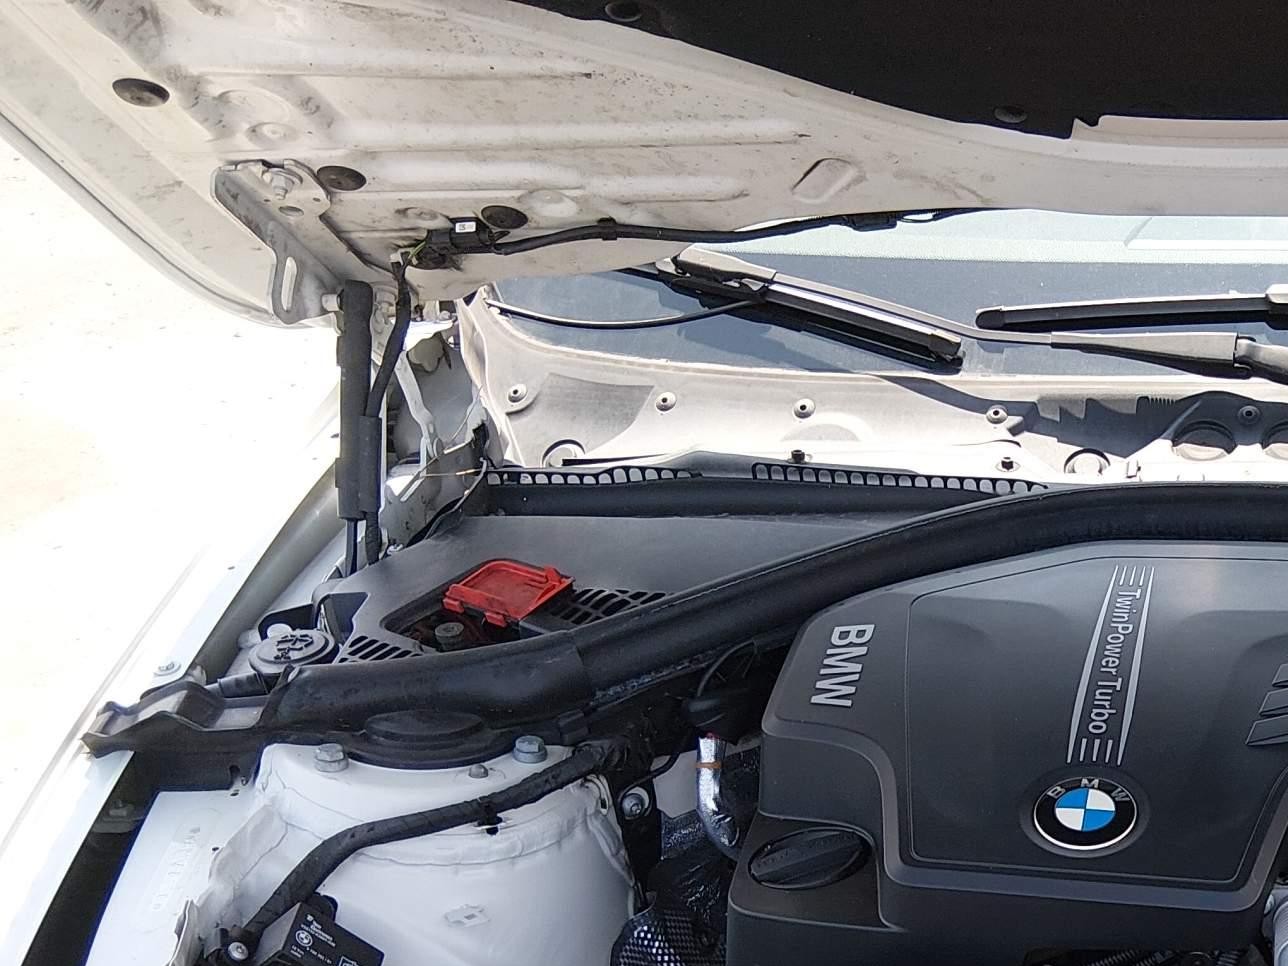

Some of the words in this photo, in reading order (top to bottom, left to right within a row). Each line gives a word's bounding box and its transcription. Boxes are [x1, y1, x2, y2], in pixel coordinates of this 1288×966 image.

[809, 623, 875, 708] BMW
[1101, 587, 1141, 675] TwinPower
[1089, 677, 1122, 734] Turbo
[1046, 776, 1131, 802] BMW
